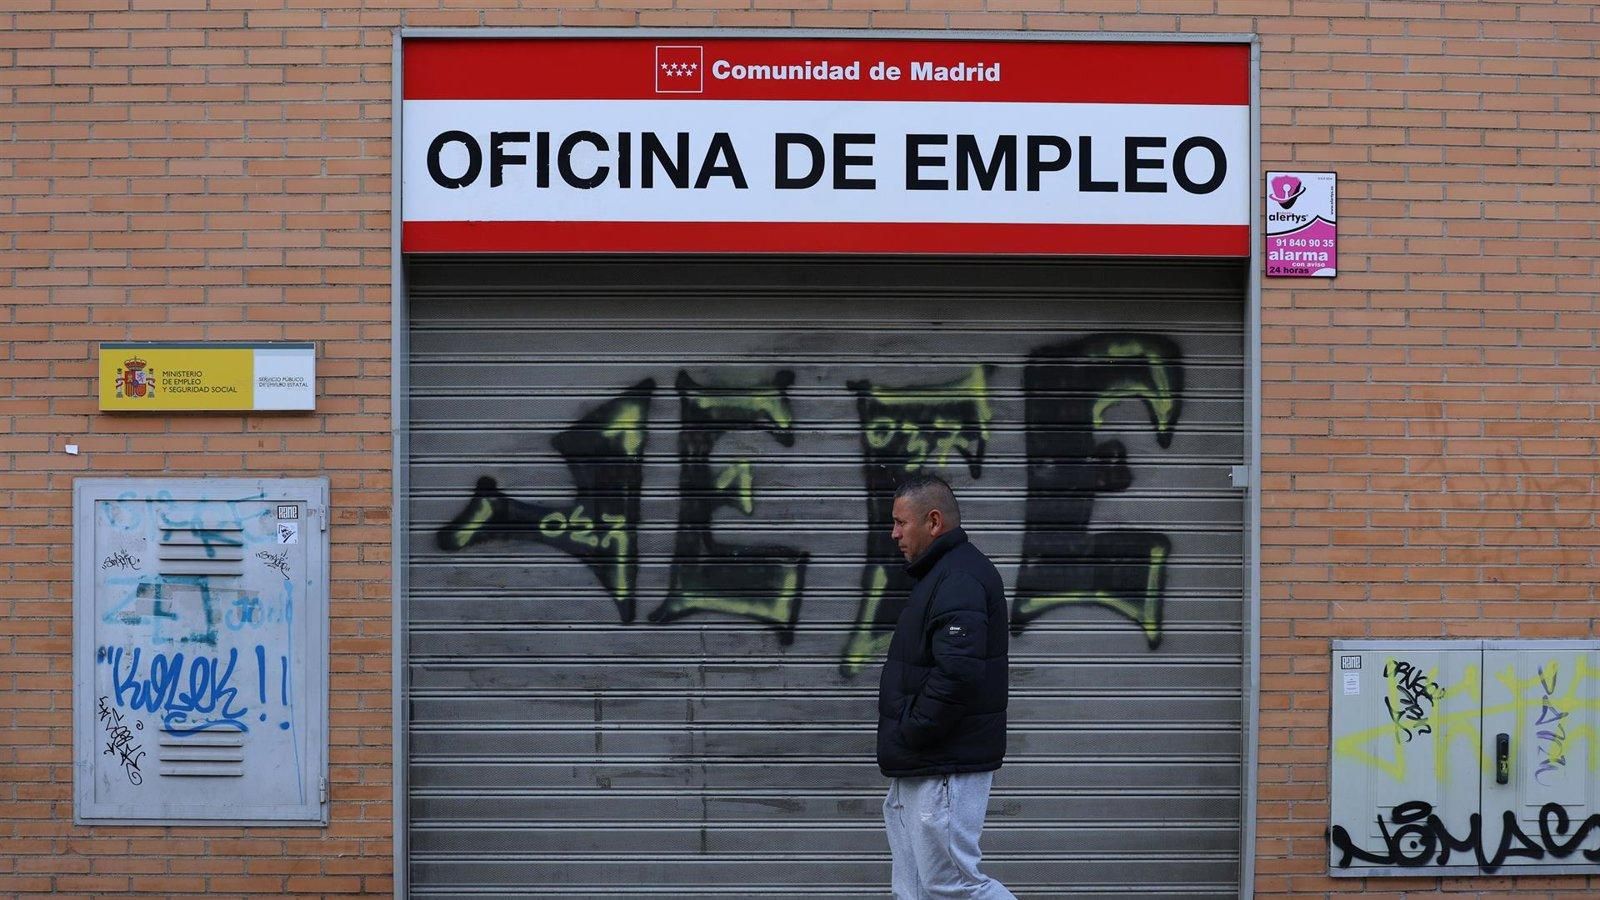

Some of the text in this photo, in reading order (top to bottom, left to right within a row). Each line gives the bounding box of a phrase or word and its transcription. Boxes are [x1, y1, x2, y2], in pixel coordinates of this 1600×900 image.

[712, 60, 1000, 82] Comunidad de Madrid
[426, 130, 1227, 195] OFICINA DE EMPLEO
[1276, 239, 1334, 248] 91 840 90 35
[1268, 249, 1328, 261] alarma
